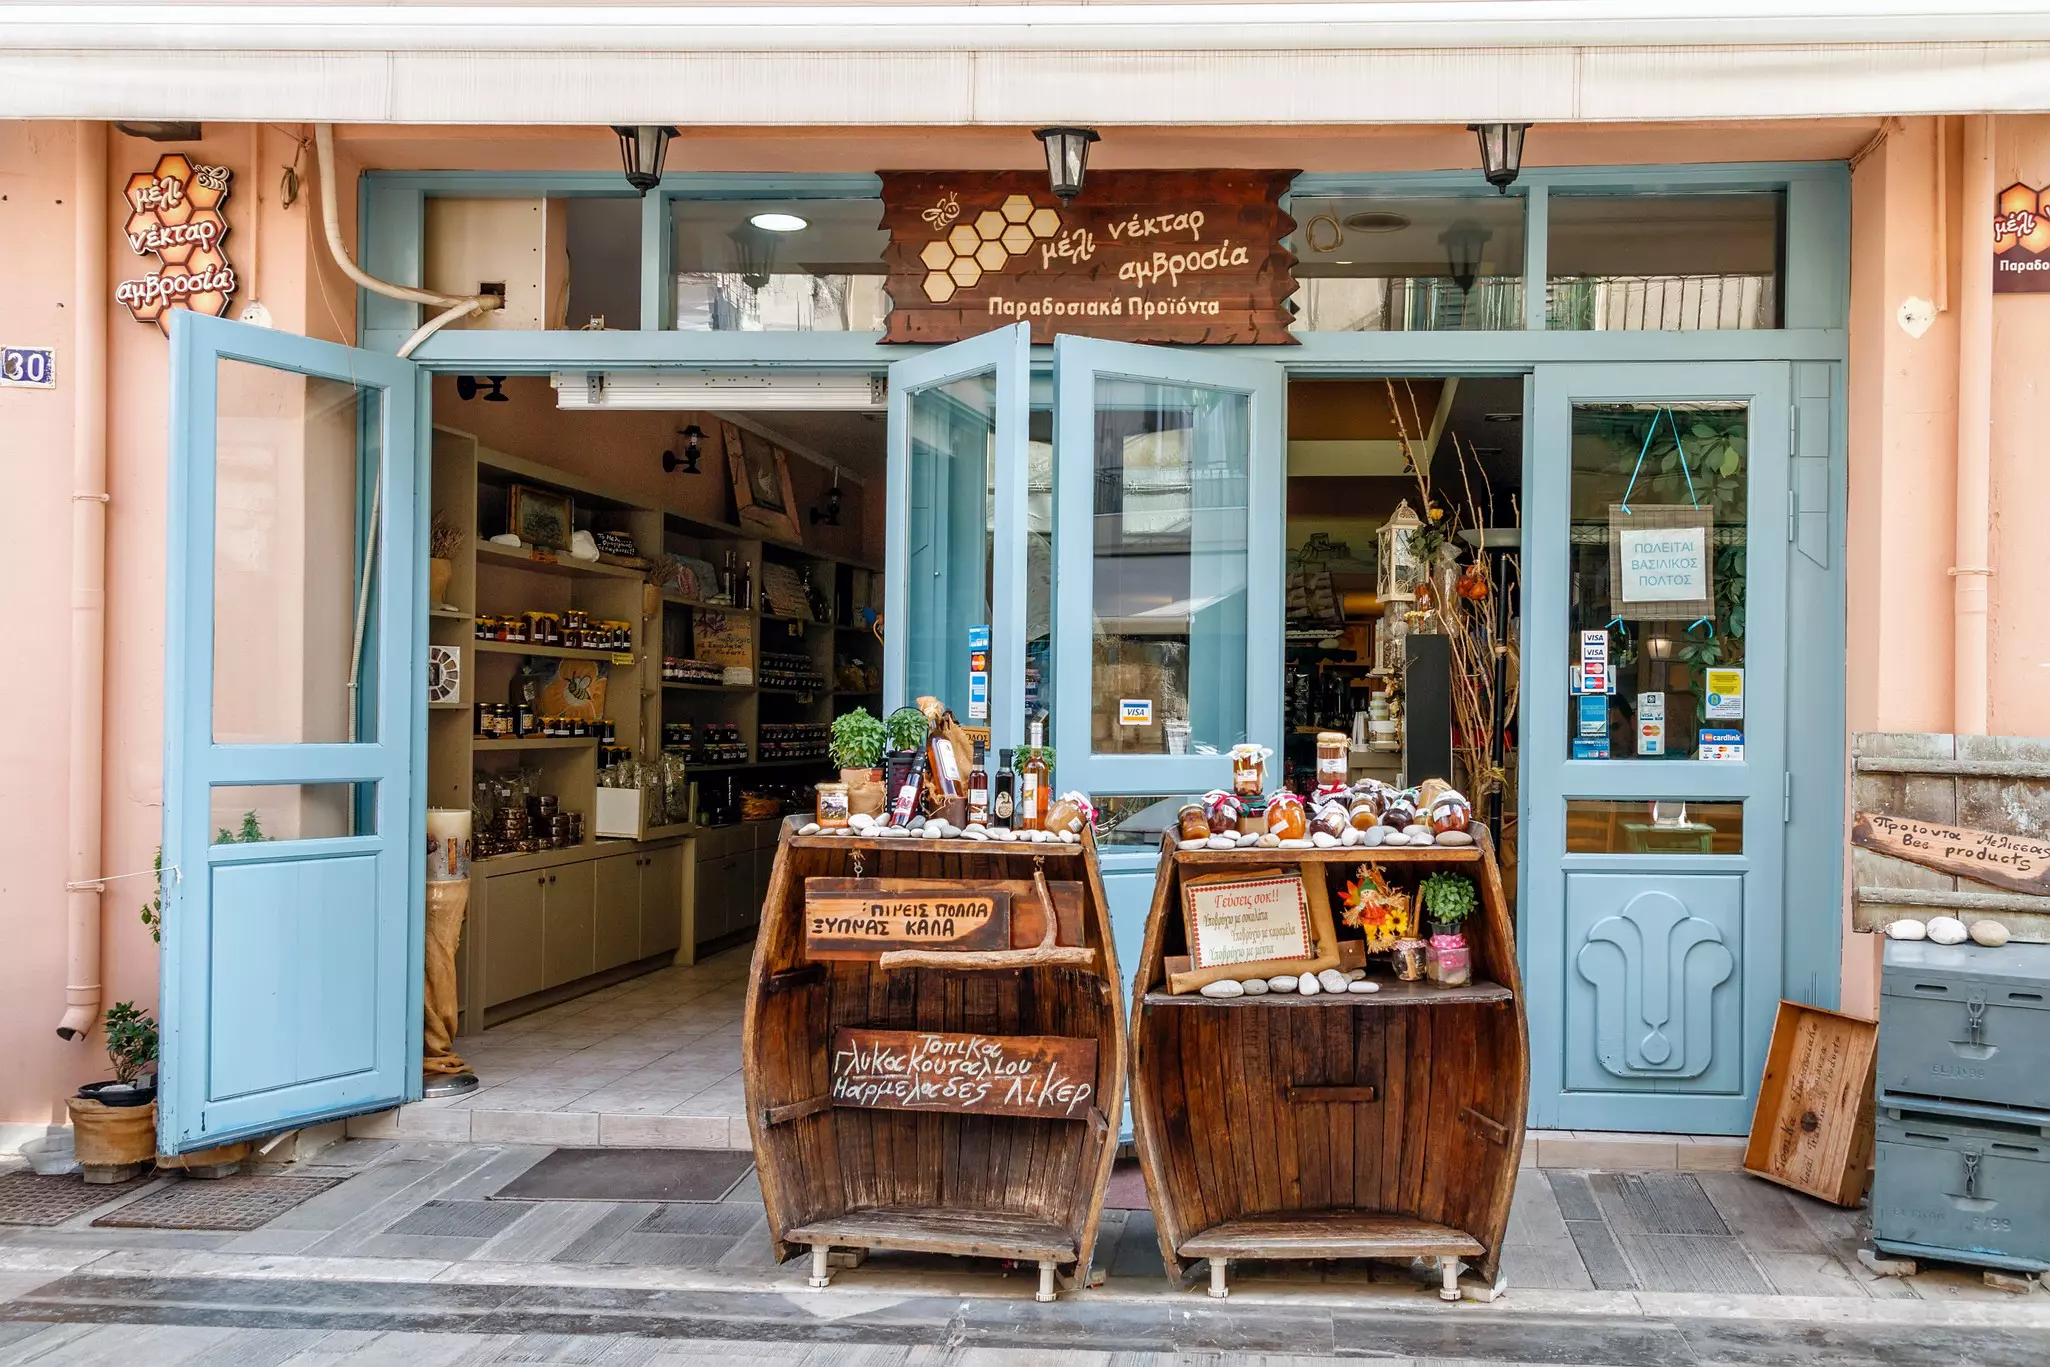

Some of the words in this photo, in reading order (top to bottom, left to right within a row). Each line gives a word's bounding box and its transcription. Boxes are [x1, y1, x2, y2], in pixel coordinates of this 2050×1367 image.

[136, 177, 183, 213] μέλι
[131, 222, 215, 250] νέκταρ
[1995, 210, 2036, 241] μέλι
[1041, 229, 1096, 268] μέλι
[1109, 210, 1204, 240] νέκταρ
[1119, 240, 1249, 288] αμβροσία
[118, 265, 230, 307] αμβροσία
[988, 297, 1122, 320] Παραδοσιακά
[1128, 297, 1220, 320] Προϊόντα
[8, 352, 44, 381] 30
[1635, 542, 1693, 554] ΠΩΛΕΙΤΑΙ
[1631, 558, 1698, 570] ΒΑΣΙΛΙΚΟΣ
[1639, 574, 1692, 586] ΠΟΛΤΟΣ
[1873, 816, 1961, 841] Προιοντα
[1903, 833, 1929, 850] Bee
[1945, 847, 2031, 871] products
[935, 903, 988, 917] ΠΟΛΛΑ
[1215, 893, 1252, 909] Γεύσεις
[1255, 889, 1279, 904] σοκ!!
[905, 918, 955, 936] ΚΑΛΑ
[1234, 915, 1241, 928] με
[1246, 948, 1253, 959] με
